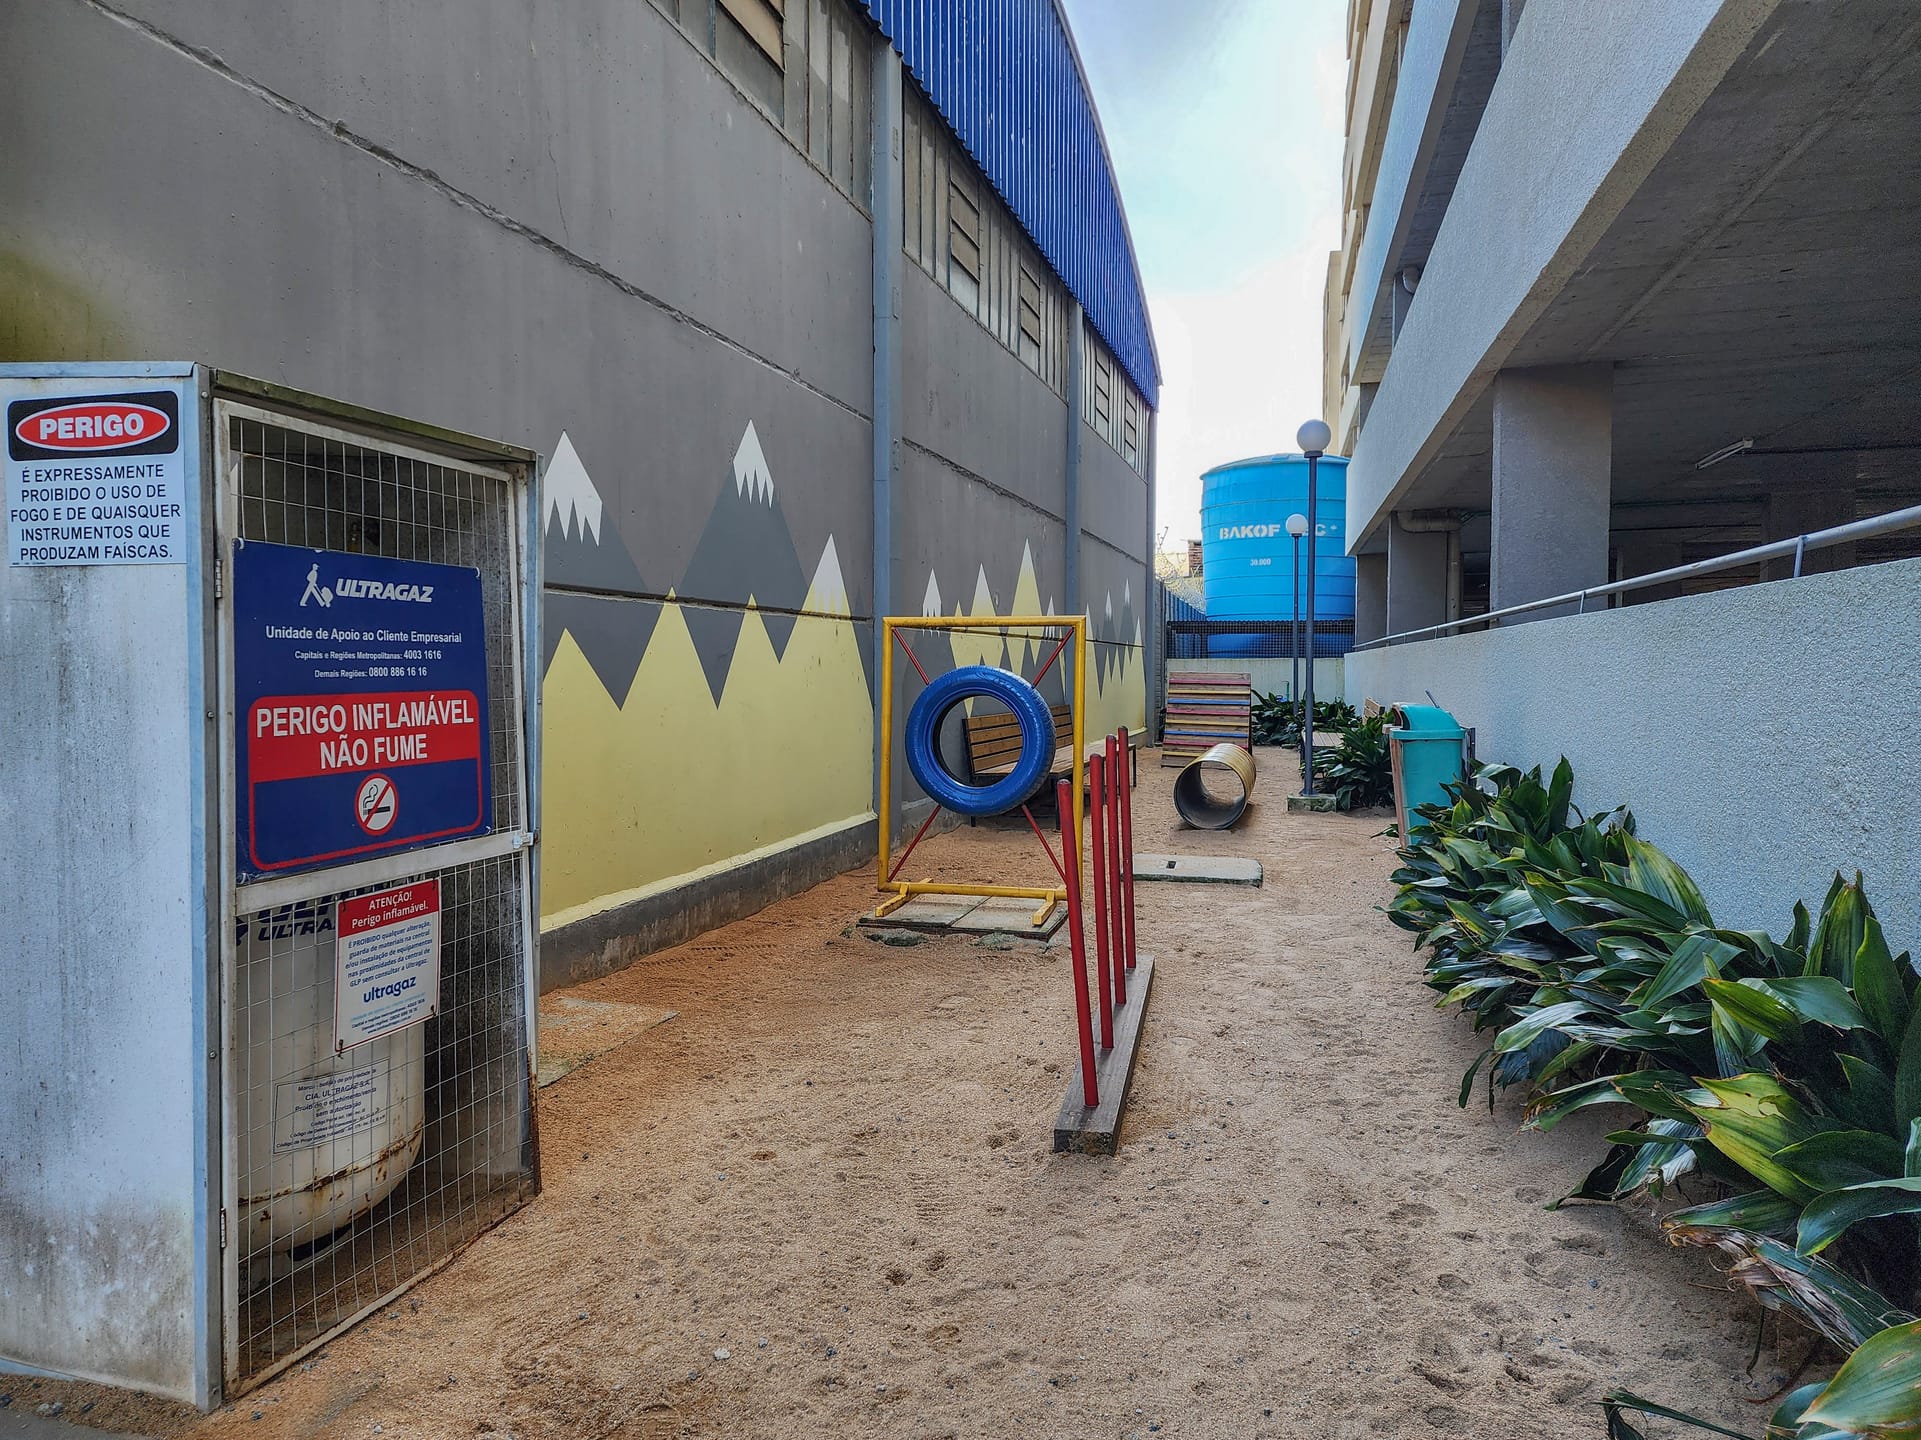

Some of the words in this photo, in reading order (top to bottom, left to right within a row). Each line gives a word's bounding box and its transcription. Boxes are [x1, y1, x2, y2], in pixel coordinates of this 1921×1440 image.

[40, 413, 144, 440] PERIGO
[22, 467, 30, 483] É
[35, 464, 164, 482] EXPRESSAMENTE
[22, 487, 91, 502] PROIBIDO
[96, 487, 106, 500] O
[111, 486, 140, 499] USO
[146, 484, 166, 498] DE
[11, 508, 49, 522] FOGO
[53, 508, 62, 521] E
[67, 507, 86, 520] DE
[91, 504, 181, 520] QUAISQUER
[21, 525, 133, 541] INSTRUMENTOS
[138, 525, 170, 539] QUE
[1220, 524, 1280, 539] BAKOF
[20, 546, 99, 560] PRODUZAM
[104, 542, 173, 559] FAÍSCAS.
[335, 578, 434, 603] ULTRAGAZ
[266, 625, 313, 640] Unidade
[316, 627, 329, 640] de
[331, 628, 360, 643] Apoio
[362, 631, 375, 641] ao
[377, 629, 409, 642] Cliente
[411, 632, 462, 644] Empresarial
[295, 651, 323, 660] Capitais
[330, 651, 356, 661] Regiões
[357, 651, 402, 661] Metropolitanas:
[403, 650, 422, 660] 4003
[424, 650, 442, 660] 1616
[315, 669, 339, 678] Demais
[340, 669, 368, 679] Regiões:
[369, 667, 388, 678] 0800
[390, 667, 405, 678] 886
[407, 667, 416, 677] 16
[418, 667, 427, 677] 16
[256, 704, 347, 738] PERIGO
[352, 694, 474, 731] INFLAMÁVEL
[320, 734, 369, 769] NÃO
[373, 733, 428, 764] FUME
[368, 890, 413, 911] ATENÇÃO!
[351, 913, 381, 929] Perigo
[382, 901, 429, 921] inflamável.
[349, 947, 369, 960] guarda
[379, 938, 404, 950] materiais
[412, 930, 430, 939] central
[352, 934, 381, 947] PROIBIDO
[382, 928, 406, 940] qualquer
[345, 960, 359, 970] e/ou
[360, 951, 388, 964] instalação
[389, 948, 396, 956] de
[397, 938, 433, 954] equipamentos
[348, 971, 359, 979] nas
[359, 959, 397, 976] proximidades
[405, 949, 423, 960] central
[349, 979, 361, 988] GLP
[362, 975, 374, 983] sem
[375, 966, 400, 979] consultar
[363, 976, 417, 1003] ultragaz
[305, 1093, 320, 1101] CIA.
